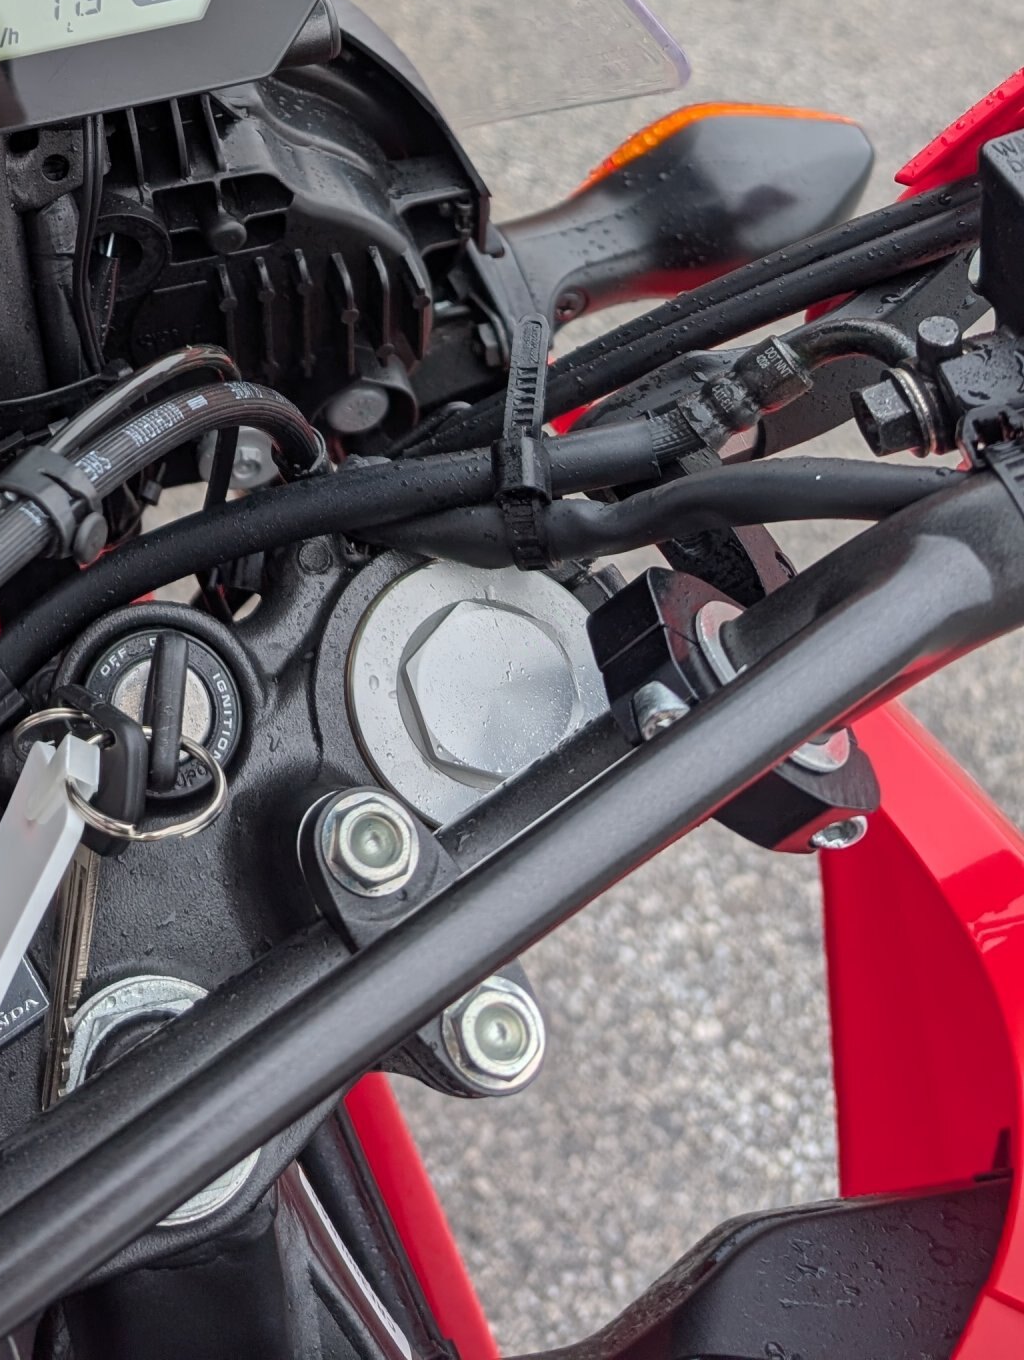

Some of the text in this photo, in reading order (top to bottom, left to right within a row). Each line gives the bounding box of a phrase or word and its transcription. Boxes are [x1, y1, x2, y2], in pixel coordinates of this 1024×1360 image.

[764, 346, 779, 362] DOT
[75, 401, 185, 482] NICHIRIN SAE
[100, 647, 127, 677] OFF
